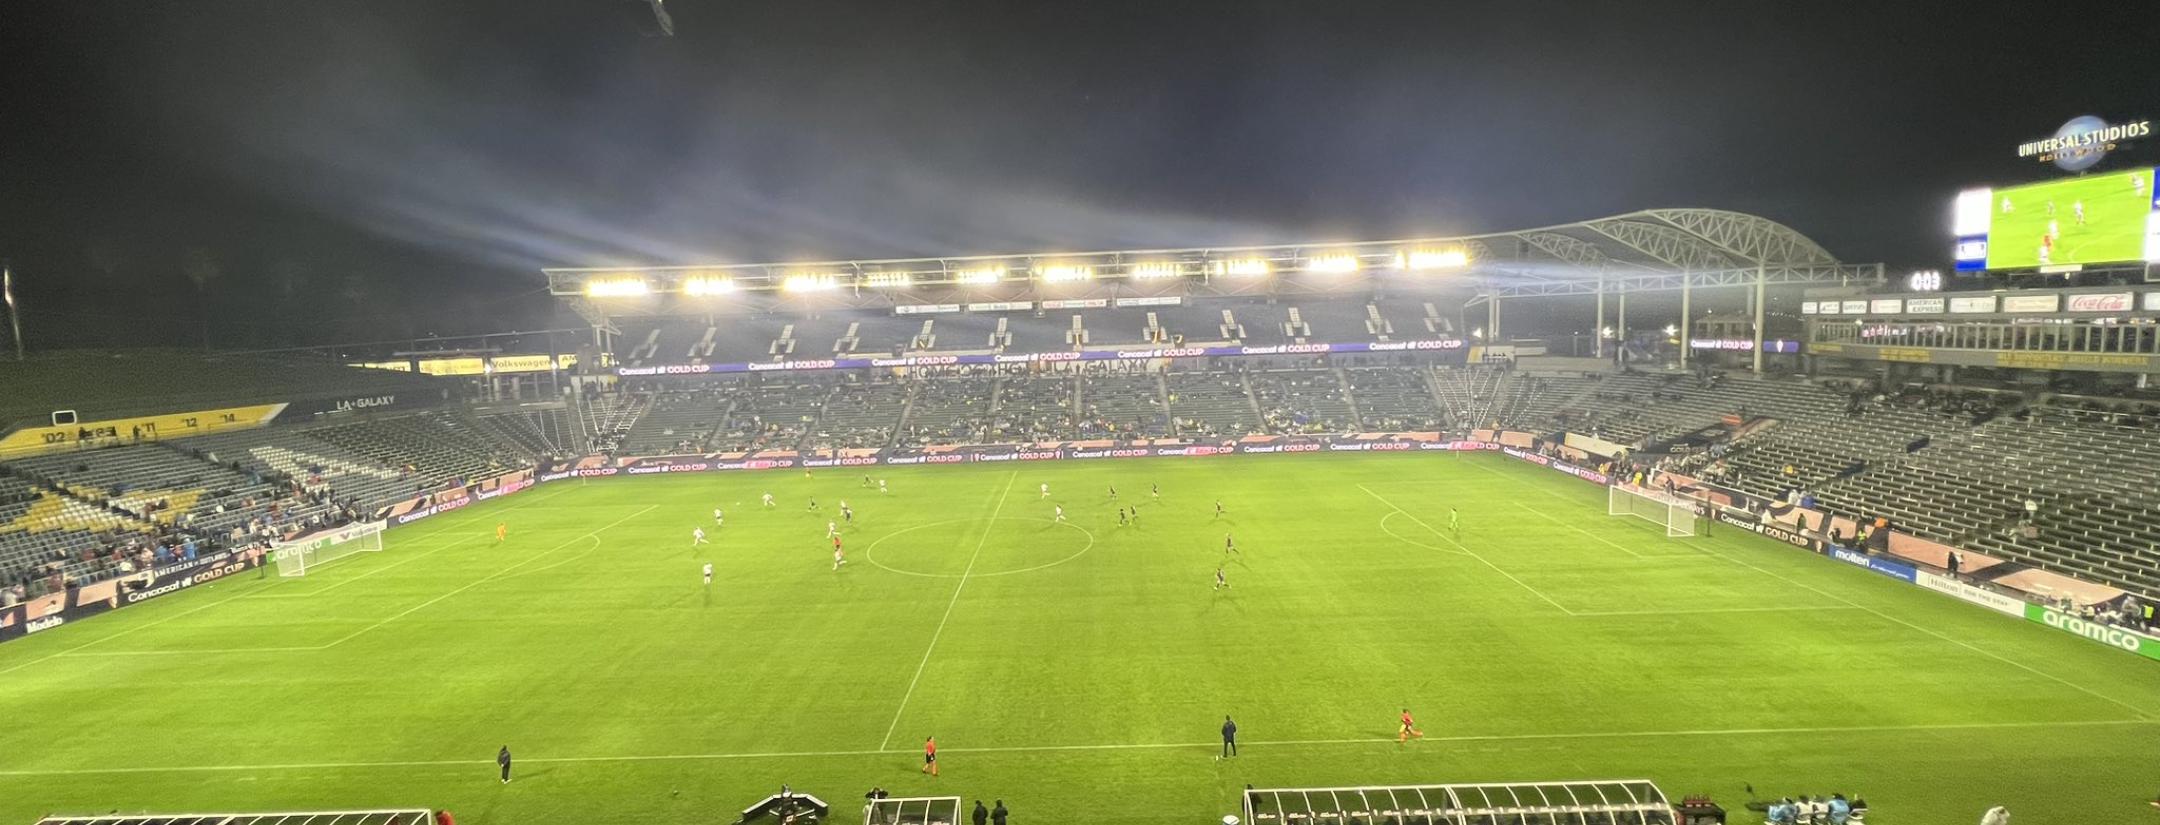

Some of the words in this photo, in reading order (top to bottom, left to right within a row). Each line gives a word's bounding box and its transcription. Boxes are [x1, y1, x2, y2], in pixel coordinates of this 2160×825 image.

[2018, 136, 2081, 157] UNIVERSAL
[2083, 121, 2150, 145] STUDIOS
[2039, 143, 2117, 162] HOLLYWOOD
[1312, 344, 1330, 352] CUP
[1443, 340, 1461, 348] CUP
[1063, 352, 1080, 360] CUP
[1187, 348, 1204, 356] CUP
[491, 360, 552, 369] Volkswagen
[818, 360, 835, 368] CUP
[940, 356, 958, 364] CUP
[692, 364, 710, 373] CUP
[337, 401, 352, 411] LA
[357, 396, 395, 408] GALAXY
[1721, 513, 1755, 531] Concacaf
[1765, 526, 1788, 541] GOLD
[1789, 534, 1808, 546] CUP
[1835, 550, 1869, 567] molten
[128, 580, 179, 602] Concacaf
[194, 568, 223, 583] GOLD
[224, 562, 245, 574] CUP
[26, 615, 63, 634] Modelo
[2043, 610, 2140, 651] aramco
